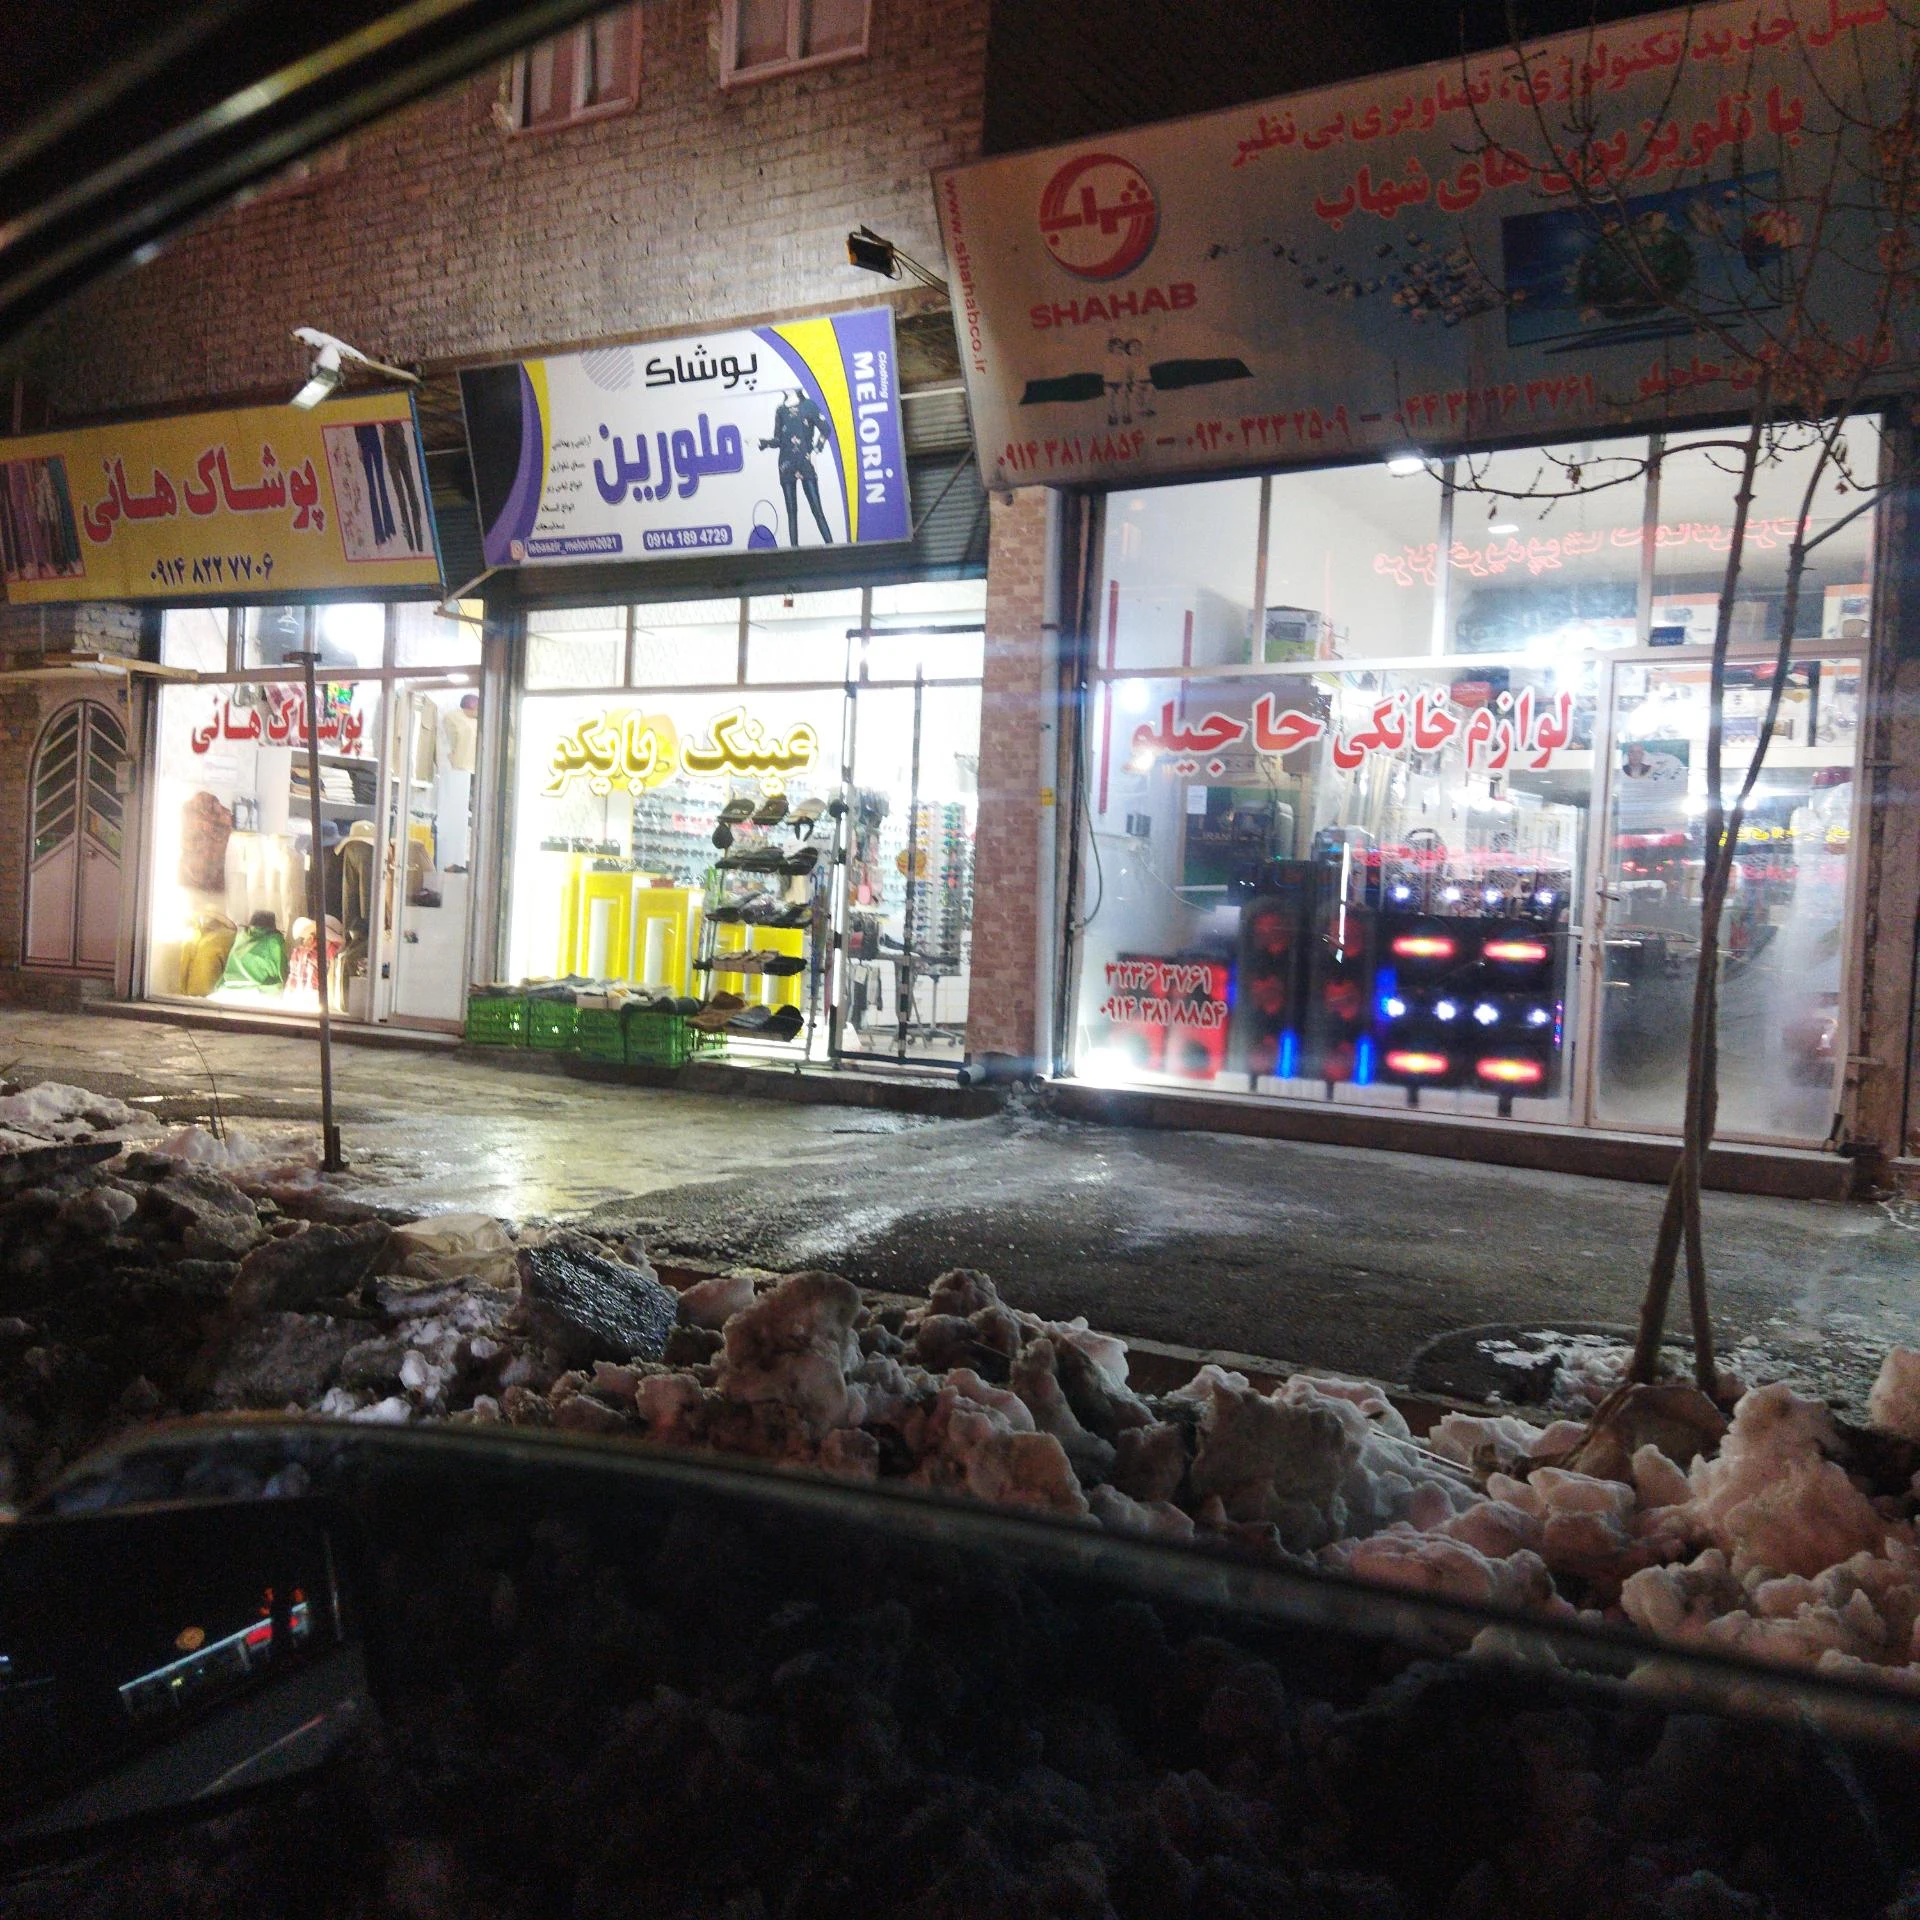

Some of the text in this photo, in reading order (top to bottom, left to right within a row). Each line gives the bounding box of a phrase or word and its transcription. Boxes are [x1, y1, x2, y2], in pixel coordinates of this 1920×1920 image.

[1692, 18, 1798, 63] جدید
[1233, 111, 1296, 167] نظیر
[1303, 113, 1345, 150] بی
[1767, 84, 1804, 148] با
[1316, 157, 1429, 228] شهاب
[1437, 146, 1531, 212] های
[945, 177, 986, 374] www.shahabco.ir
[1029, 282, 1198, 330] SHAHAB
[645, 344, 758, 391] پوشاک
[184, 444, 324, 532] پوشاک
[594, 413, 743, 505] ملورین
[83, 455, 177, 543] هانی
[646, 527, 729, 548] 0914 189 4729
[151, 557, 185, 586] ۰۹۱۴
[191, 696, 363, 757] پوشاک هانی
[680, 706, 819, 797] عینک
[1332, 691, 1459, 769] خانگی
[1465, 688, 1574, 770] لوازم
